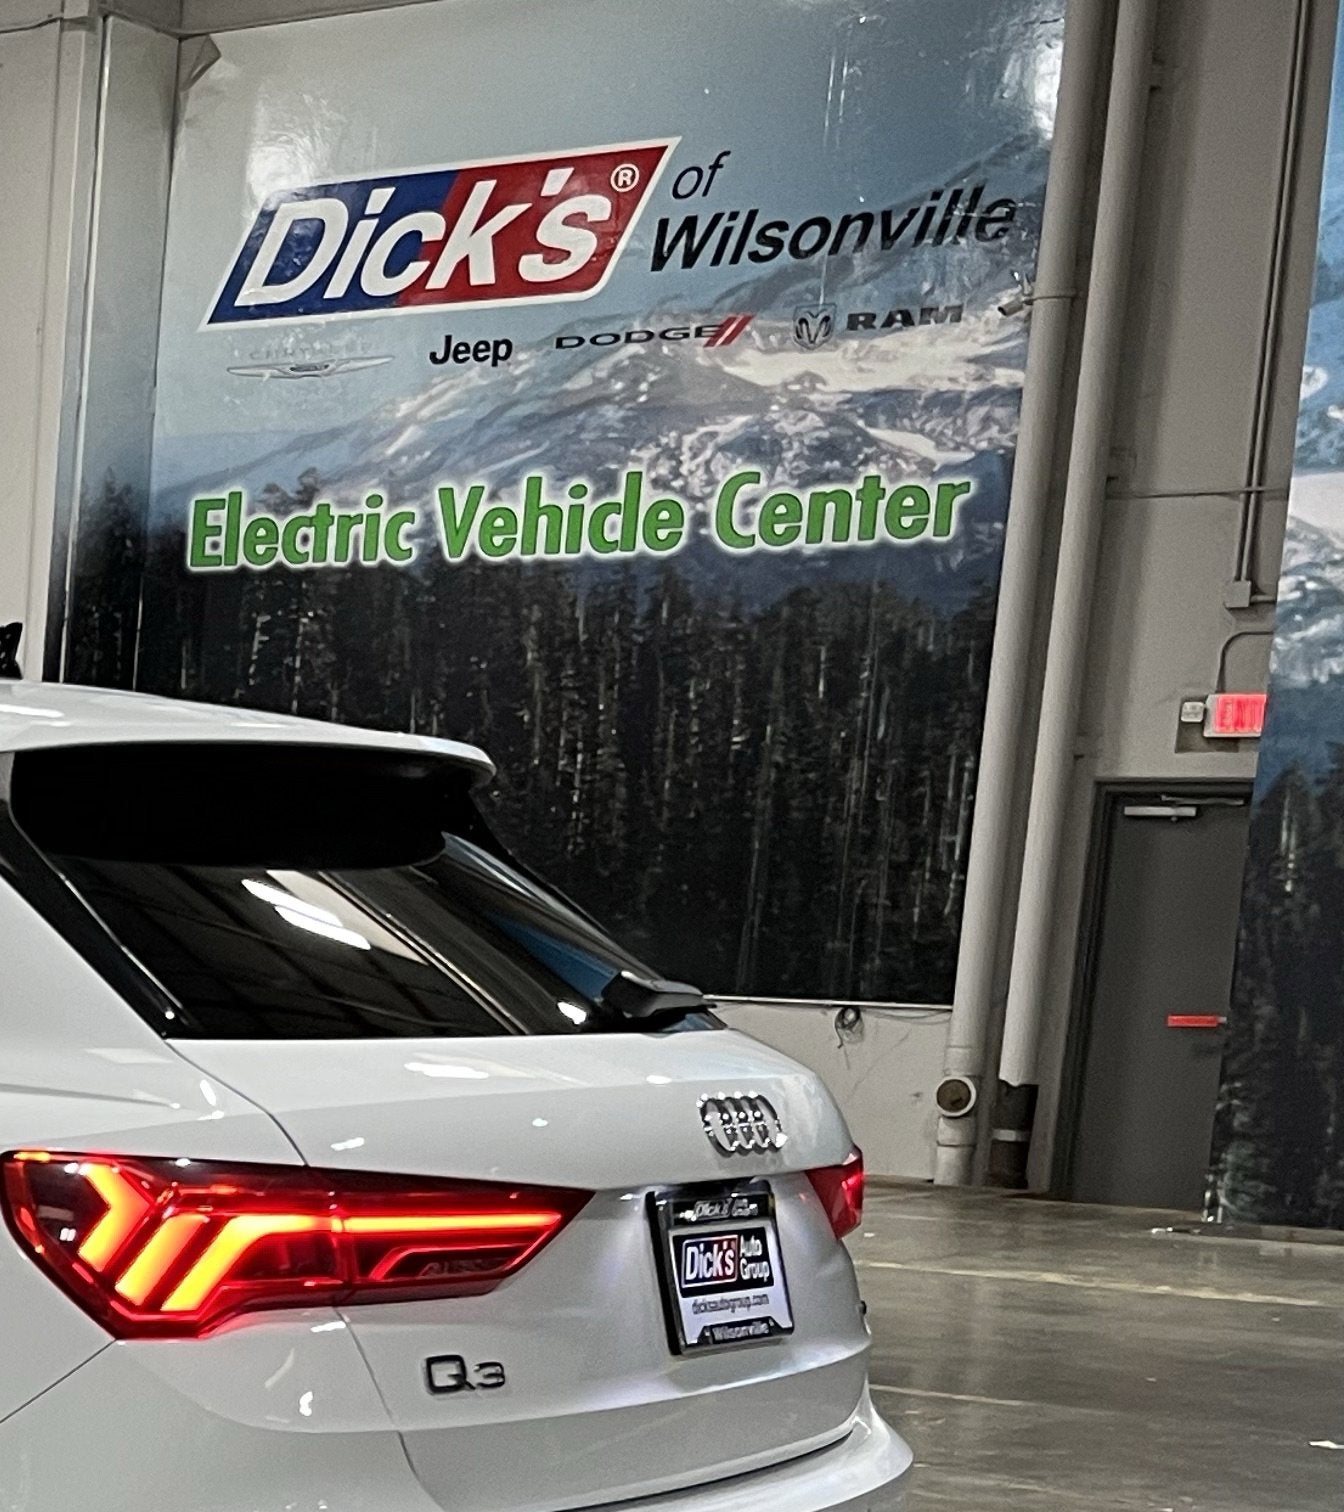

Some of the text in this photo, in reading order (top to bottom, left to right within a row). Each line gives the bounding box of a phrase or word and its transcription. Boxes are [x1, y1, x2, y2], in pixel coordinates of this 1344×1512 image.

[671, 151, 731, 200] of
[650, 178, 1016, 273] Wilsonville
[847, 303, 966, 332] RAM
[429, 334, 513, 367] Jeep
[555, 323, 720, 350] DODGE
[189, 470, 972, 568] Electric Vehicle Center
[740, 1234, 763, 1258] Auto
[740, 1257, 771, 1283] Group
[424, 1354, 506, 1396] Q3
